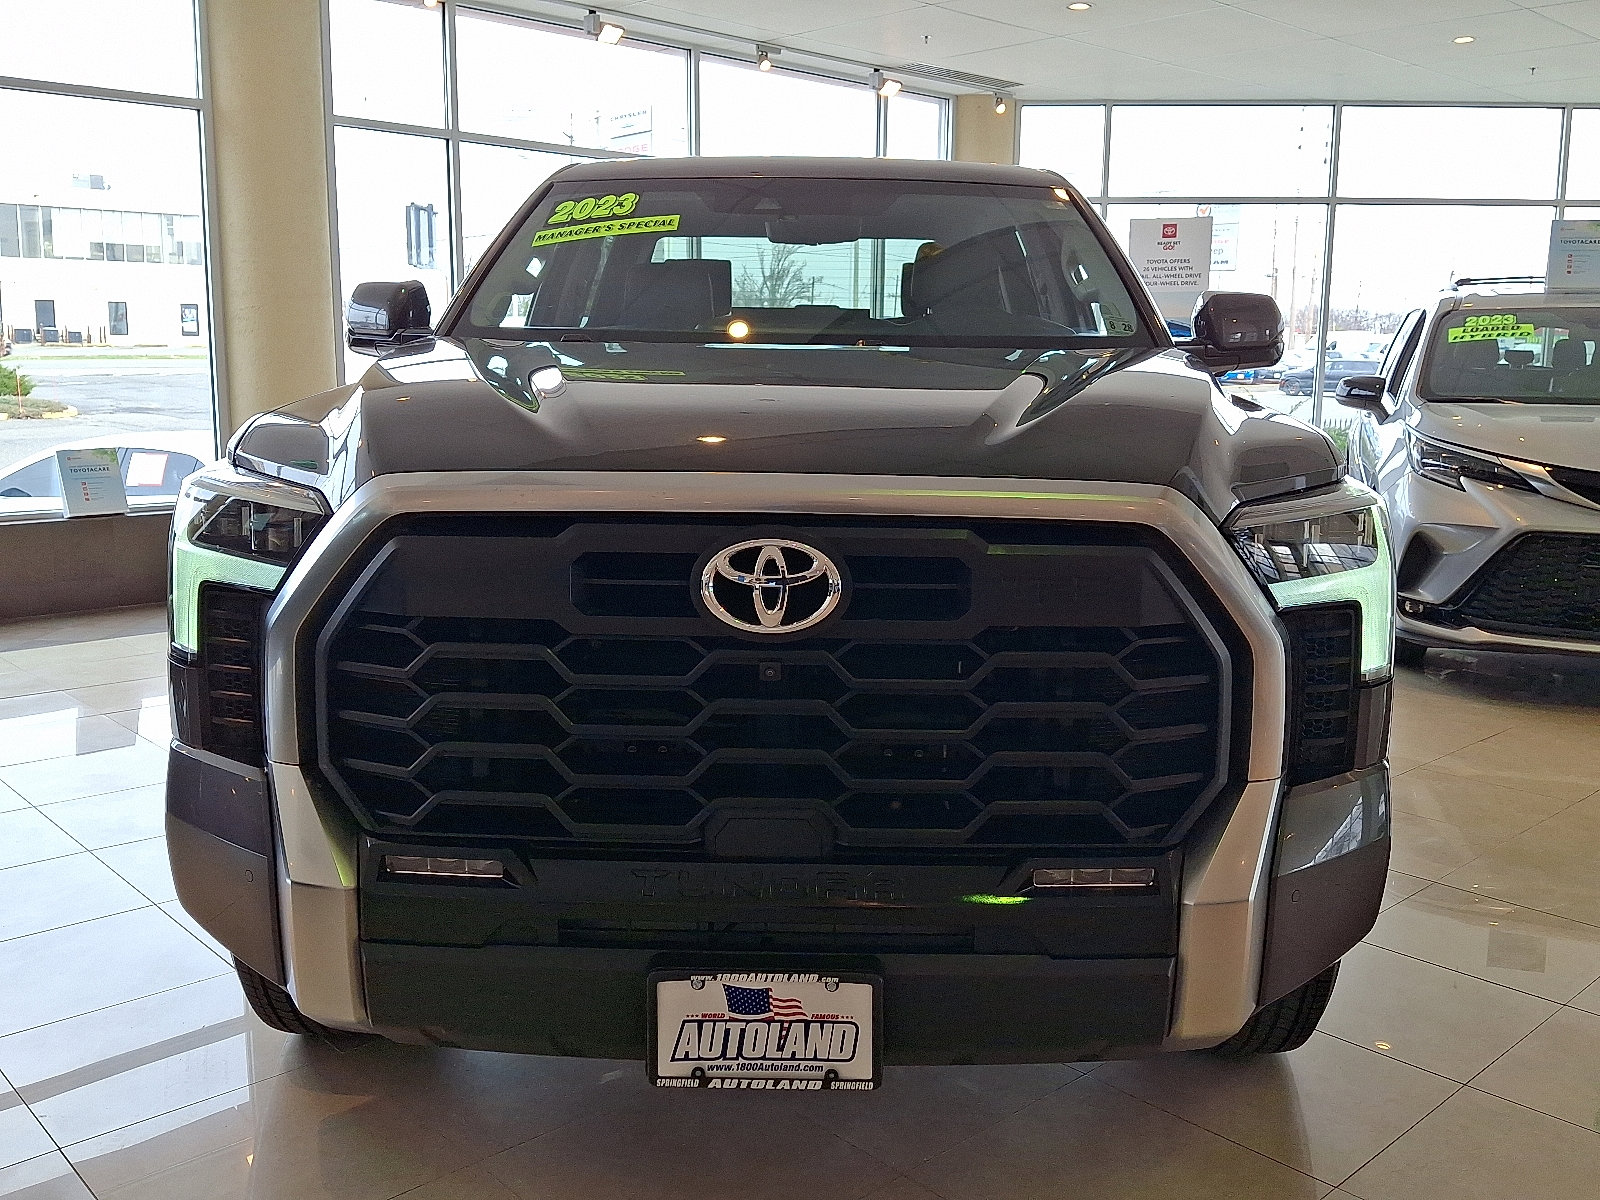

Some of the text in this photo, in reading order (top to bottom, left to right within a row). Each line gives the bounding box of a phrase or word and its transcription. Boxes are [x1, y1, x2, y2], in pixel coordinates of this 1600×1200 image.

[547, 193, 639, 224] 2023
[534, 218, 676, 243] MANAGER'S SPECIAL
[1465, 314, 1516, 326] 2023
[1109, 320, 1134, 333] 8 28
[1462, 325, 1522, 333] LOADED
[1452, 331, 1532, 341] HYBRID
[690, 973, 839, 984] www.1800AUTOLAND.com
[672, 1020, 857, 1062] AUTOLAND
[707, 1063, 824, 1073] www.1800Autoland.com
[656, 1078, 874, 1091] SPRINGFIELD AUTOLAND SPRINGFIELD
